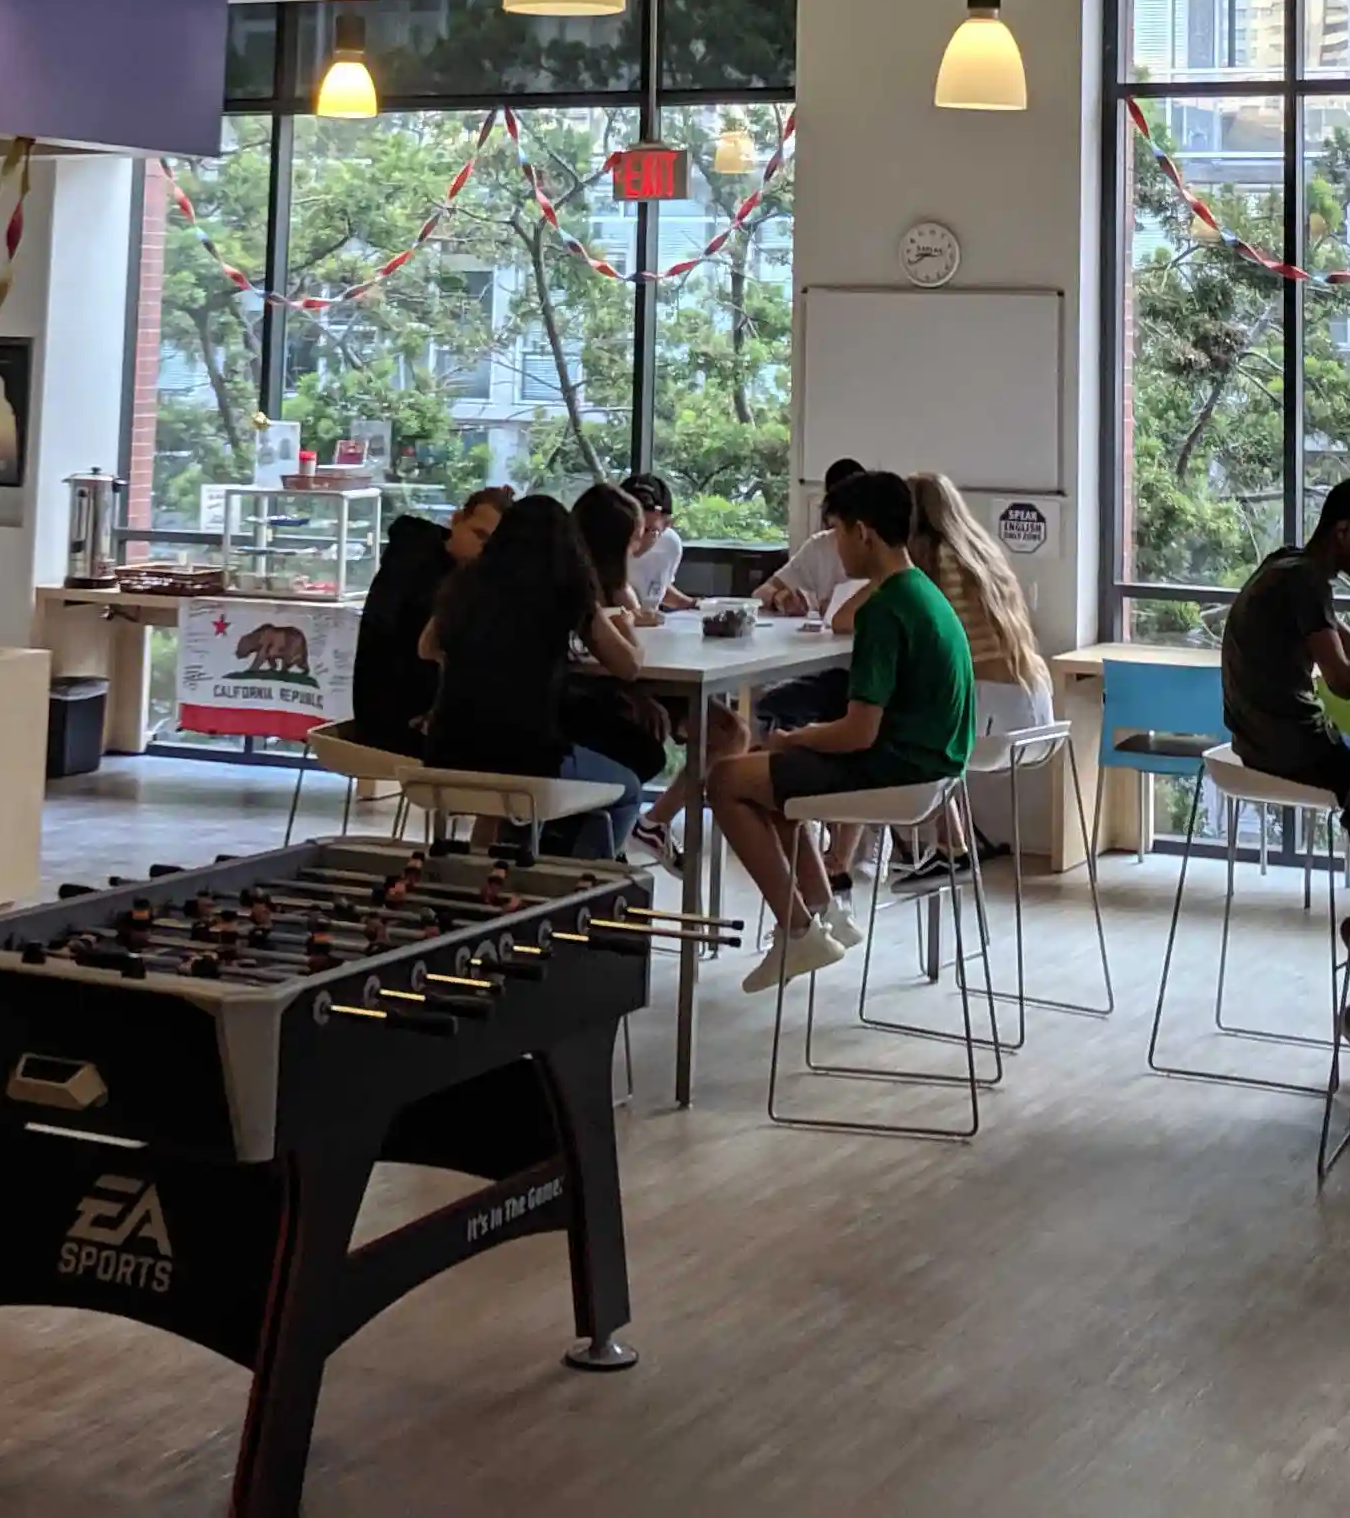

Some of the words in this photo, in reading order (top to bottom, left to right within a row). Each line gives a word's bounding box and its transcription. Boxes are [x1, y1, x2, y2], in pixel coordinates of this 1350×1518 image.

[624, 152, 677, 198] EXIT
[1004, 521, 1042, 532] ENGLISH
[1008, 509, 1038, 521] SPEAK
[213, 684, 273, 700] CALIFORNIA
[280, 688, 324, 710] REPUBLIC
[65, 1173, 173, 1259] EA
[504, 1195, 526, 1223] The
[57, 1241, 173, 1294] SPORTS
